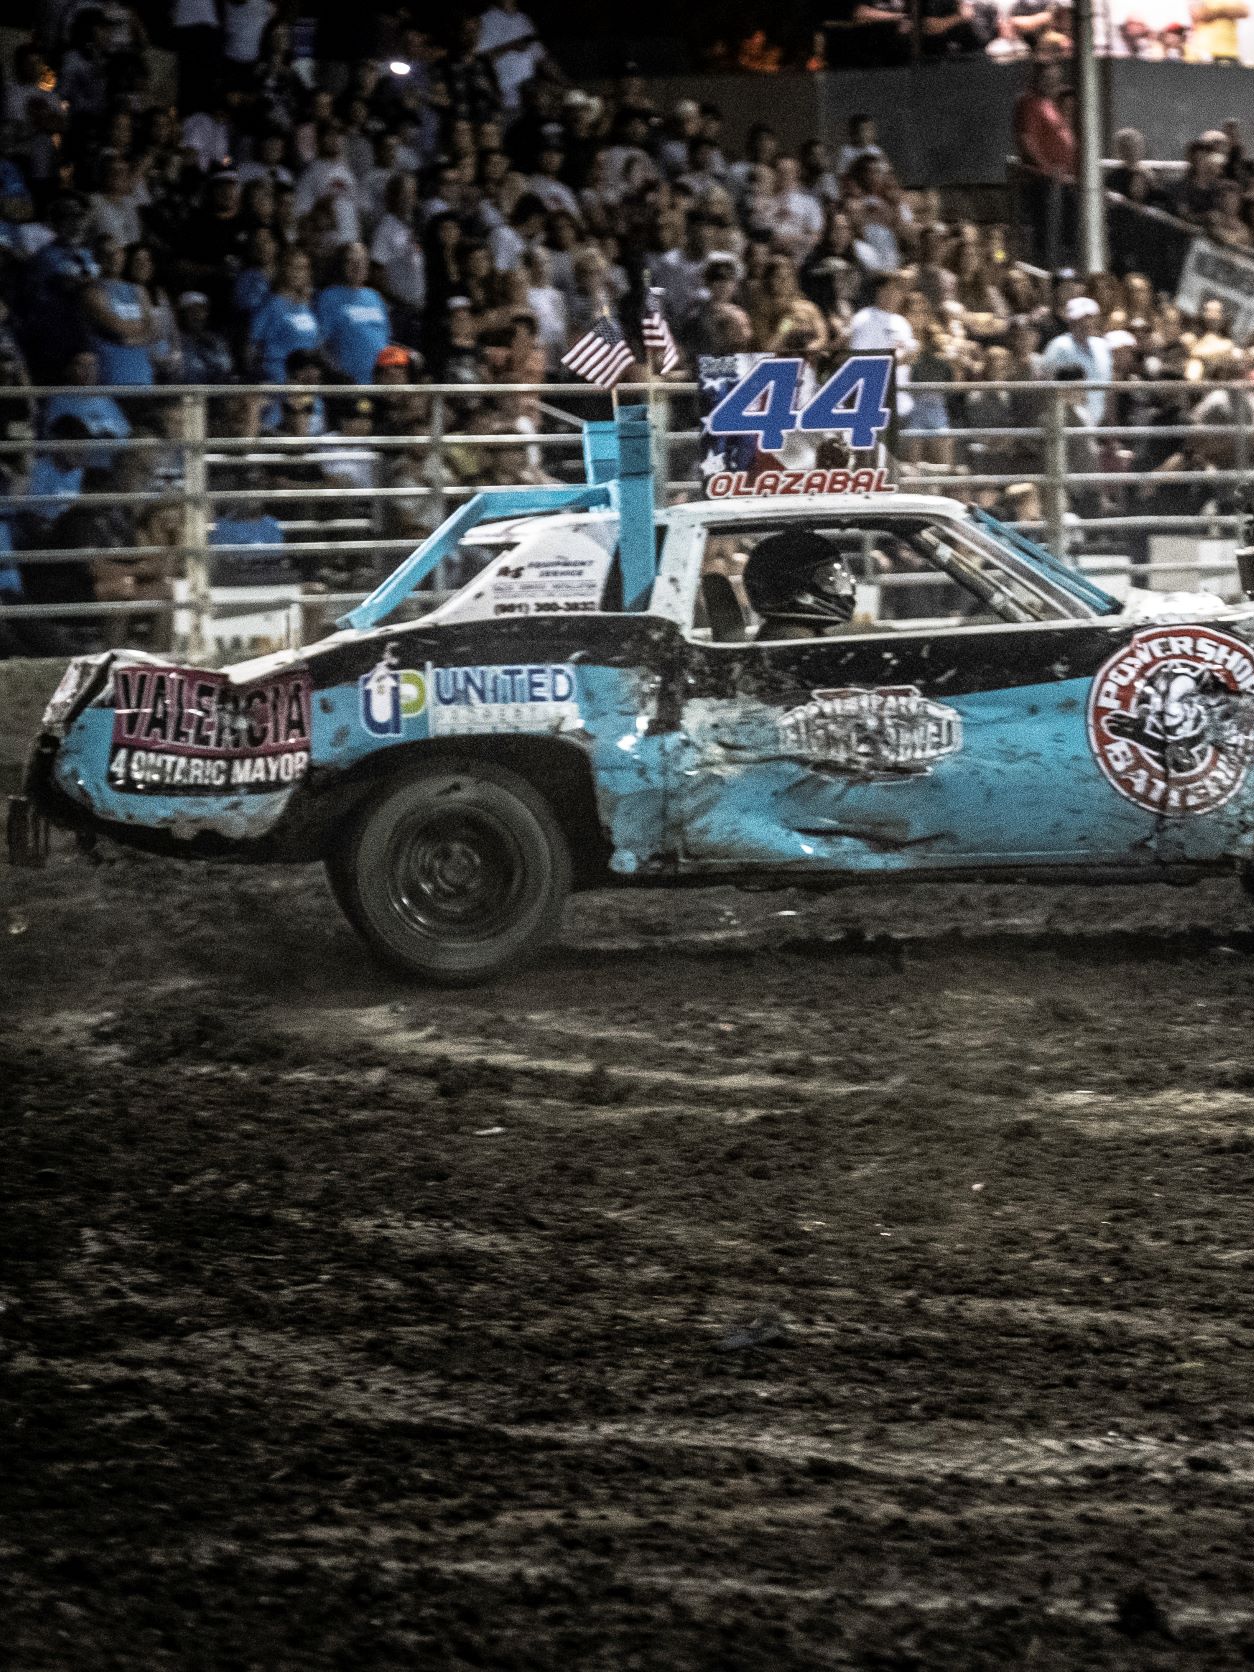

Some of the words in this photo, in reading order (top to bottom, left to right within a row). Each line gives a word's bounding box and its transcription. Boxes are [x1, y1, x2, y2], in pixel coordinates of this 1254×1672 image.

[708, 356, 894, 451] 44
[708, 468, 898, 499] OLAZABAL
[434, 667, 575, 705] UNITED
[109, 748, 128, 778] 4
[230, 750, 309, 784] MAYOR
